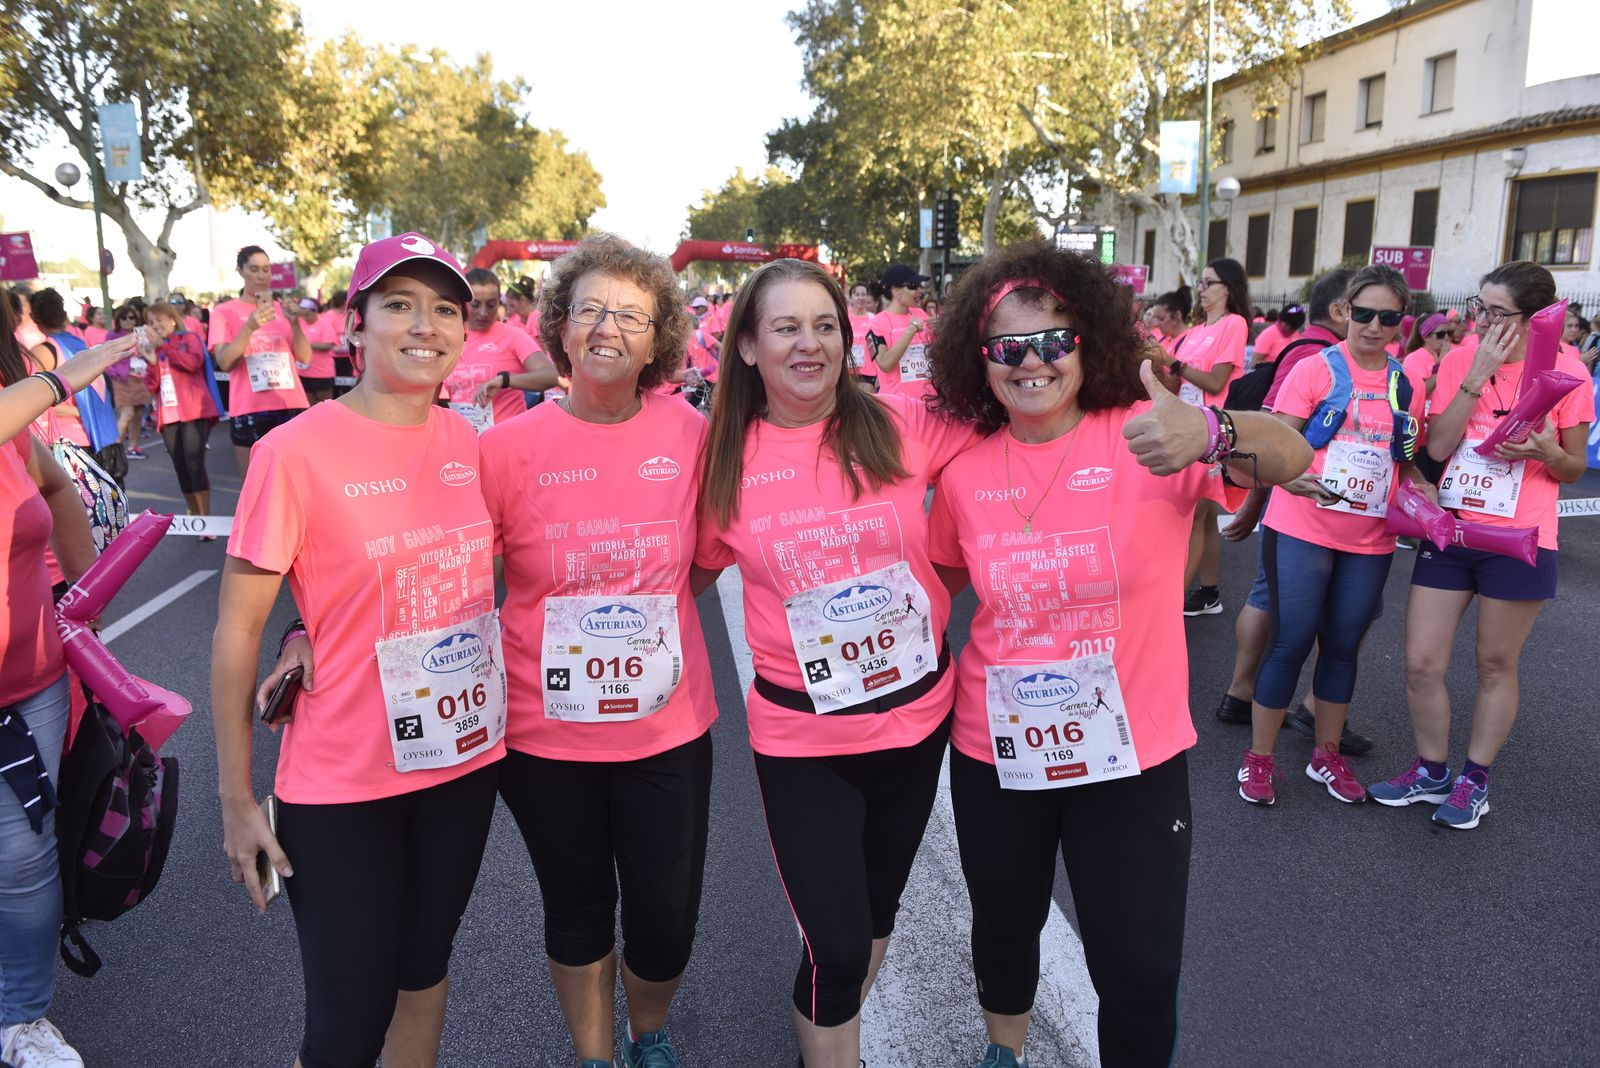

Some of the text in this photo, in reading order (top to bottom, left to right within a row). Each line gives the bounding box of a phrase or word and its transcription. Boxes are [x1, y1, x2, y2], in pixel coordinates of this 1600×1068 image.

[1375, 250, 1404, 264] SUB
[539, 468, 598, 487] OYSHO
[741, 468, 795, 489] OYSHO
[1347, 477, 1374, 492] 016
[1459, 473, 1493, 488] 016
[344, 478, 407, 497] OYSHO
[975, 486, 1026, 502] OYSHO
[1464, 488, 1482, 496] 5044
[576, 517, 620, 537] GANAN
[750, 506, 826, 534] HOY GANAN
[797, 527, 836, 541] VITORIA
[845, 517, 884, 533] GASTEIZ
[364, 524, 446, 560] HOY GANAN
[591, 538, 626, 553] VITORIA
[634, 535, 669, 548] GASTEIZ
[821, 533, 860, 548] MADRID
[1000, 531, 1043, 547] GANAN
[421, 547, 453, 564] VITORIA
[610, 548, 646, 561] MADRID
[1011, 550, 1046, 562] VITORIA
[1056, 544, 1095, 557] GASTEIZ
[439, 554, 471, 571] MADRID
[1031, 558, 1068, 571] MADRID
[443, 597, 461, 614] LAS
[830, 594, 888, 618] ASTURIANA
[1039, 598, 1060, 611] LAS
[875, 608, 900, 622] Carrera
[1048, 607, 1115, 631] CHICAS
[585, 618, 643, 630] ASTURIANA
[627, 637, 651, 645] Carrera
[841, 628, 895, 662] 016
[1024, 635, 1053, 646] CORUÑA
[1070, 636, 1115, 660] 2019
[429, 645, 481, 669] ASTURIANA
[586, 656, 643, 679] 016
[860, 656, 888, 674] 3436
[873, 673, 895, 685] Santander
[601, 684, 630, 694] 1166
[818, 687, 852, 702] OYSHO
[1016, 686, 1075, 700] ASTURIANA
[437, 683, 486, 720] 016
[551, 702, 585, 712] OYSHO
[1060, 702, 1088, 712] Carrera
[1079, 709, 1098, 720] Mujer
[455, 714, 480, 733] 3859
[1025, 721, 1084, 748] 016
[403, 749, 443, 761] OYSHO
[1044, 750, 1074, 762] 1169
[1004, 771, 1034, 780] OYSHO
[1057, 768, 1082, 776] Santander
[1103, 764, 1128, 774] ZURICH
